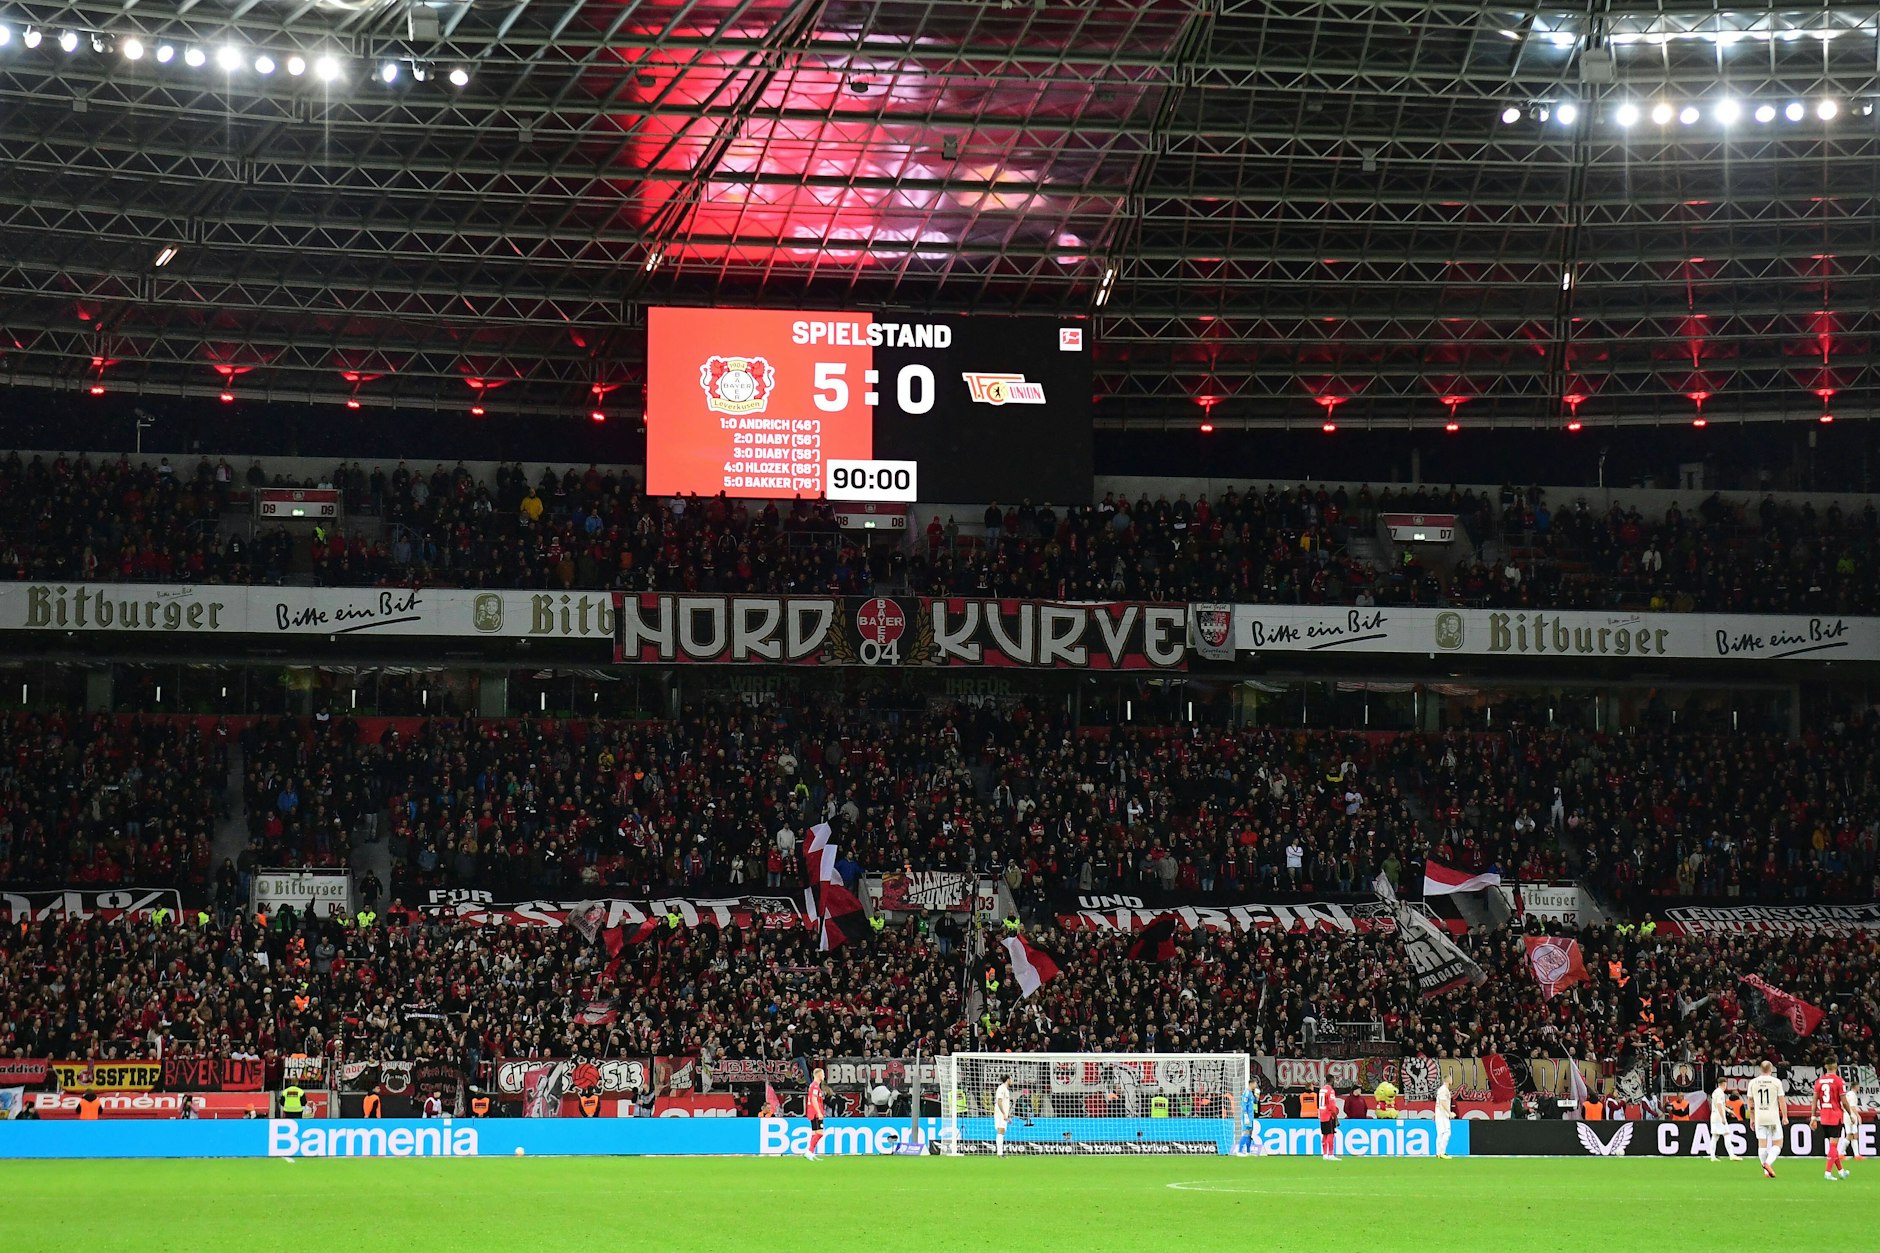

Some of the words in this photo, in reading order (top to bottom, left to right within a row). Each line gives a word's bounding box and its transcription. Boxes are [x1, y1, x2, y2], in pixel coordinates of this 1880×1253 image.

[792, 321, 951, 348] SPIELSTAND
[813, 362, 848, 412] 5
[897, 364, 935, 414] 0
[1009, 386, 1042, 400] UNION
[714, 400, 760, 410] Leverkusen
[720, 419, 737, 431] 1:0
[739, 419, 790, 431] ANDRICH
[734, 433, 753, 445] 2:0
[755, 433, 789, 445] DIABY
[734, 448, 753, 459] 3:0
[755, 448, 789, 460] DIABY
[723, 462, 743, 474] 4:0
[745, 462, 790, 475] HLOZEK
[723, 477, 743, 488] 5:0
[745, 477, 791, 489] BAKKER
[833, 468, 910, 490] 90:00
[263, 504, 276, 513] D9
[321, 505, 334, 515] D9
[891, 517, 904, 527] D8
[1440, 529, 1451, 539] D7
[25, 585, 224, 630] Bitburger
[276, 603, 329, 630] Bitte
[335, 605, 375, 622] ein
[378, 591, 423, 615] Bit
[624, 596, 836, 660] NORD
[858, 616, 903, 627] BAYER
[876, 599, 887, 644] BAYER
[1252, 620, 1301, 647] Bitte
[1307, 621, 1344, 637] ein
[1348, 610, 1388, 632] Bit
[933, 602, 1185, 665] KURVE
[1488, 612, 1669, 656] Bitburger
[1716, 630, 1764, 655] Bitte
[1769, 630, 1806, 646] ein
[1809, 619, 1849, 641] Bit
[860, 640, 901, 665] 04
[274, 880, 343, 895] Bitburger
[909, 882, 962, 907] SKUNKS
[428, 889, 493, 904] FÜR
[979, 896, 995, 910] D3
[1078, 894, 1144, 908] UND
[1521, 891, 1577, 907] itburger
[1563, 913, 1576, 924] D2
[1437, 967, 1453, 982] 04
[284, 1057, 323, 1068] HASSIA
[165, 1059, 220, 1086] BAYER
[283, 1068, 303, 1079] LEV
[602, 1062, 644, 1088] 513
[35, 1092, 207, 1109] Bamenia
[1758, 1088, 1769, 1104] 11
[1821, 1083, 1830, 1103] 3
[269, 1119, 479, 1156] Barmenia
[1657, 1122, 1877, 1155] CASOE
